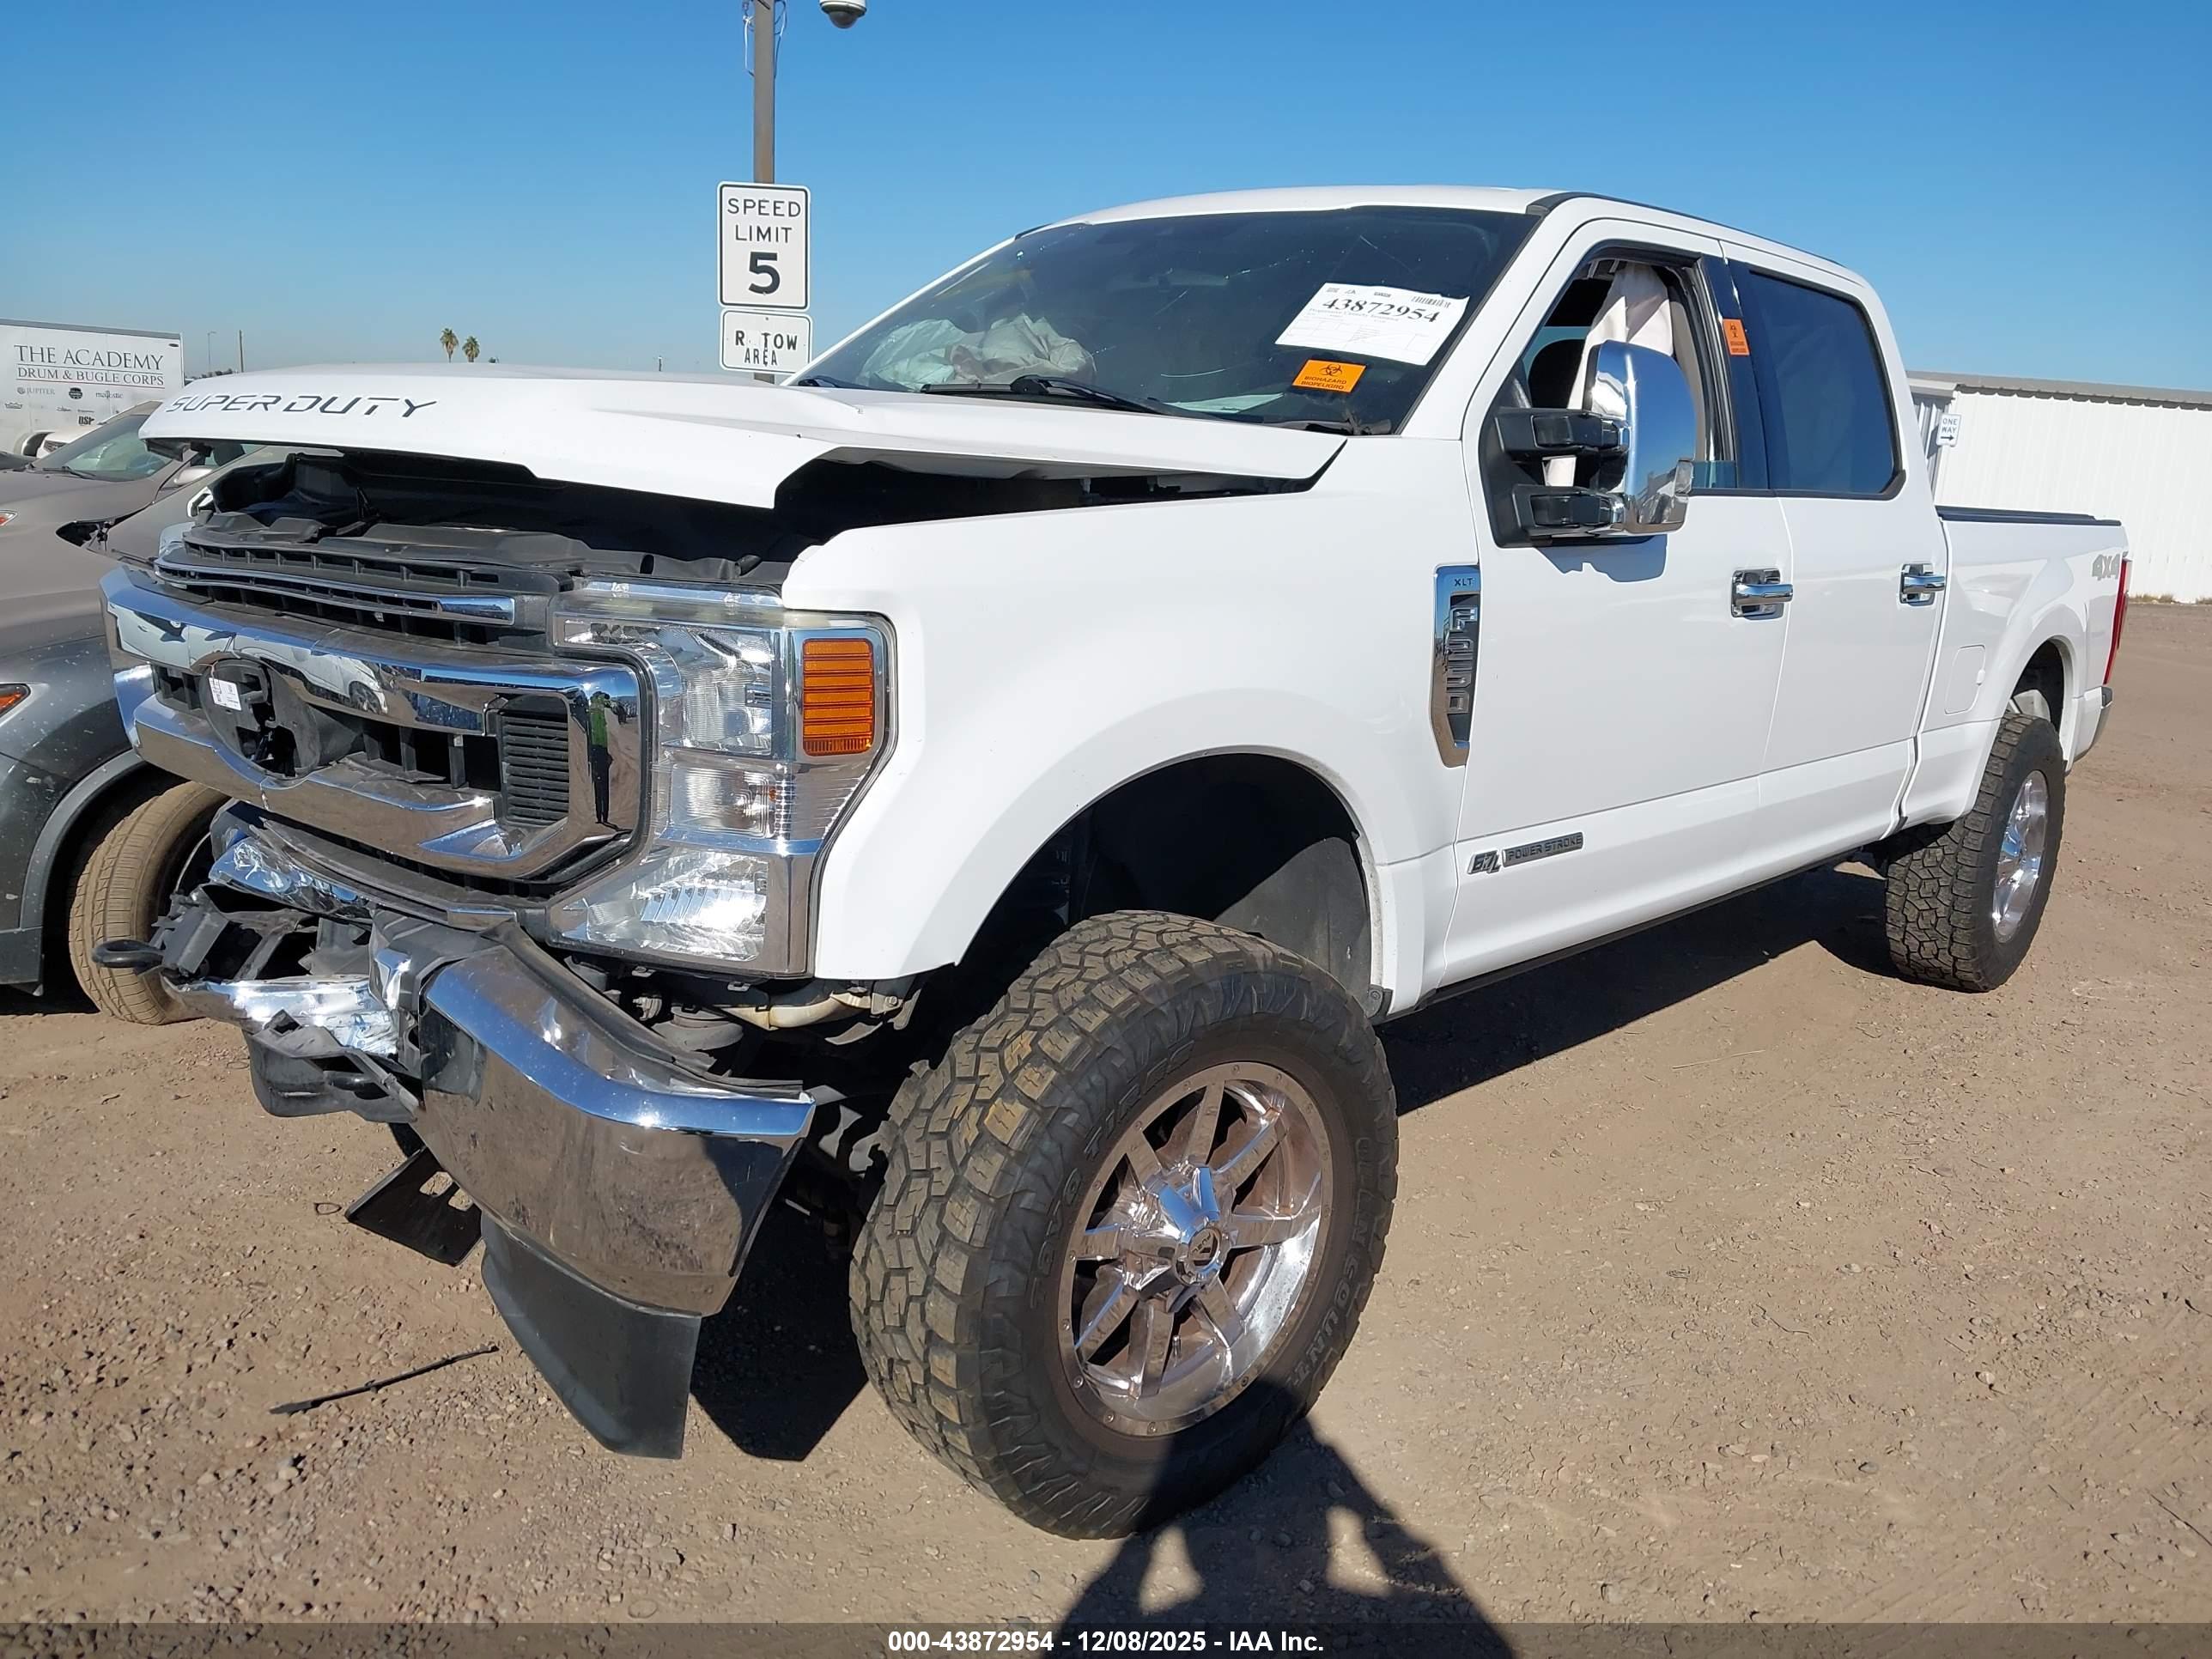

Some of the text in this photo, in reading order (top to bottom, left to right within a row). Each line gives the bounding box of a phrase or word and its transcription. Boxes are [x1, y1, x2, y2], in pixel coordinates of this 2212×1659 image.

[727, 198, 801, 217] SPEED
[735, 224, 792, 243] LIMIT
[749, 251, 781, 295] 5
[1322, 296, 1440, 324] 43872954
[762, 332, 797, 350] TOW
[14, 344, 163, 371] THE ACADEMY
[744, 347, 777, 366] AREA
[18, 367, 164, 386] DRUM & BUGLE CORPS
[1301, 380, 1345, 391] BIOPELIGRO
[1304, 375, 1347, 386] BIOHAZARD
[27, 386, 123, 399] JUPITER majestic
[166, 395, 437, 417] SUPER DUTY
[1454, 578, 1474, 587] XLT
[1507, 844, 1543, 860] POWER
[1545, 836, 1582, 852] STROKE
